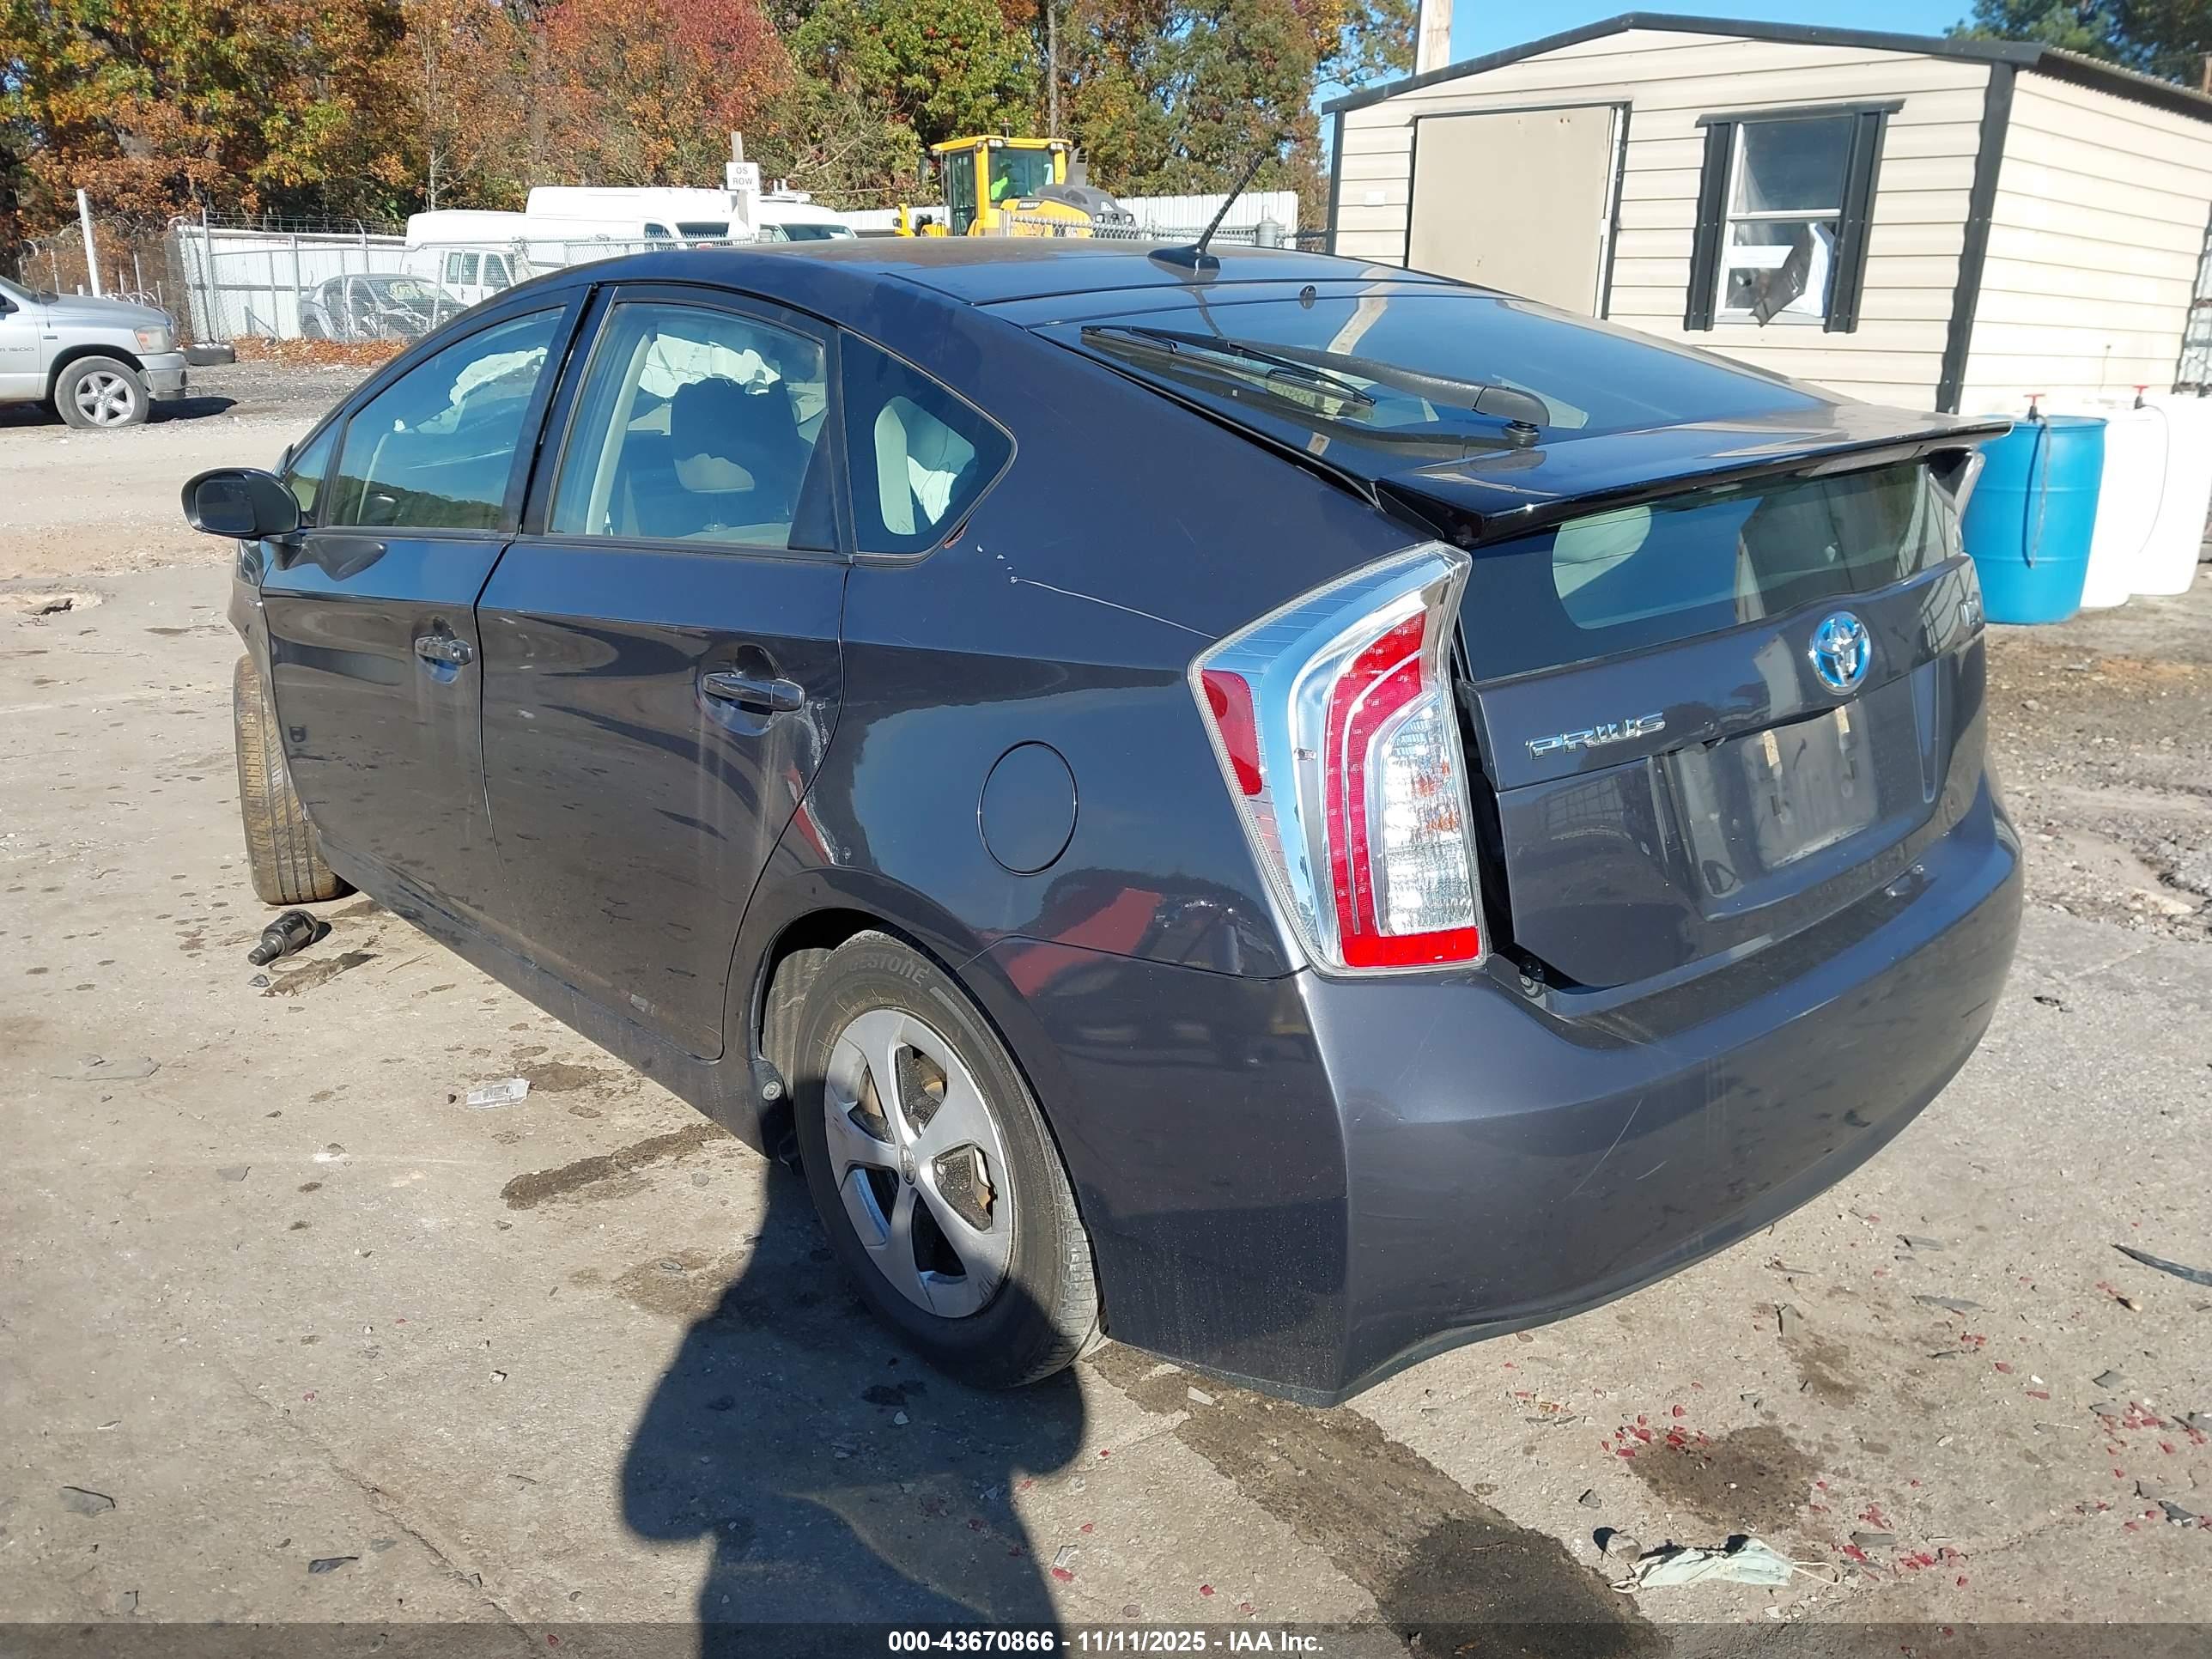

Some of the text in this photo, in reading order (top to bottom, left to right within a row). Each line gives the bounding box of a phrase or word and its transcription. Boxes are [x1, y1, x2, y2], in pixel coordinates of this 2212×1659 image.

[732, 177, 753, 185] ROW
[1525, 712, 1666, 760] PRIUS
[826, 951, 930, 989] DGESTONE
